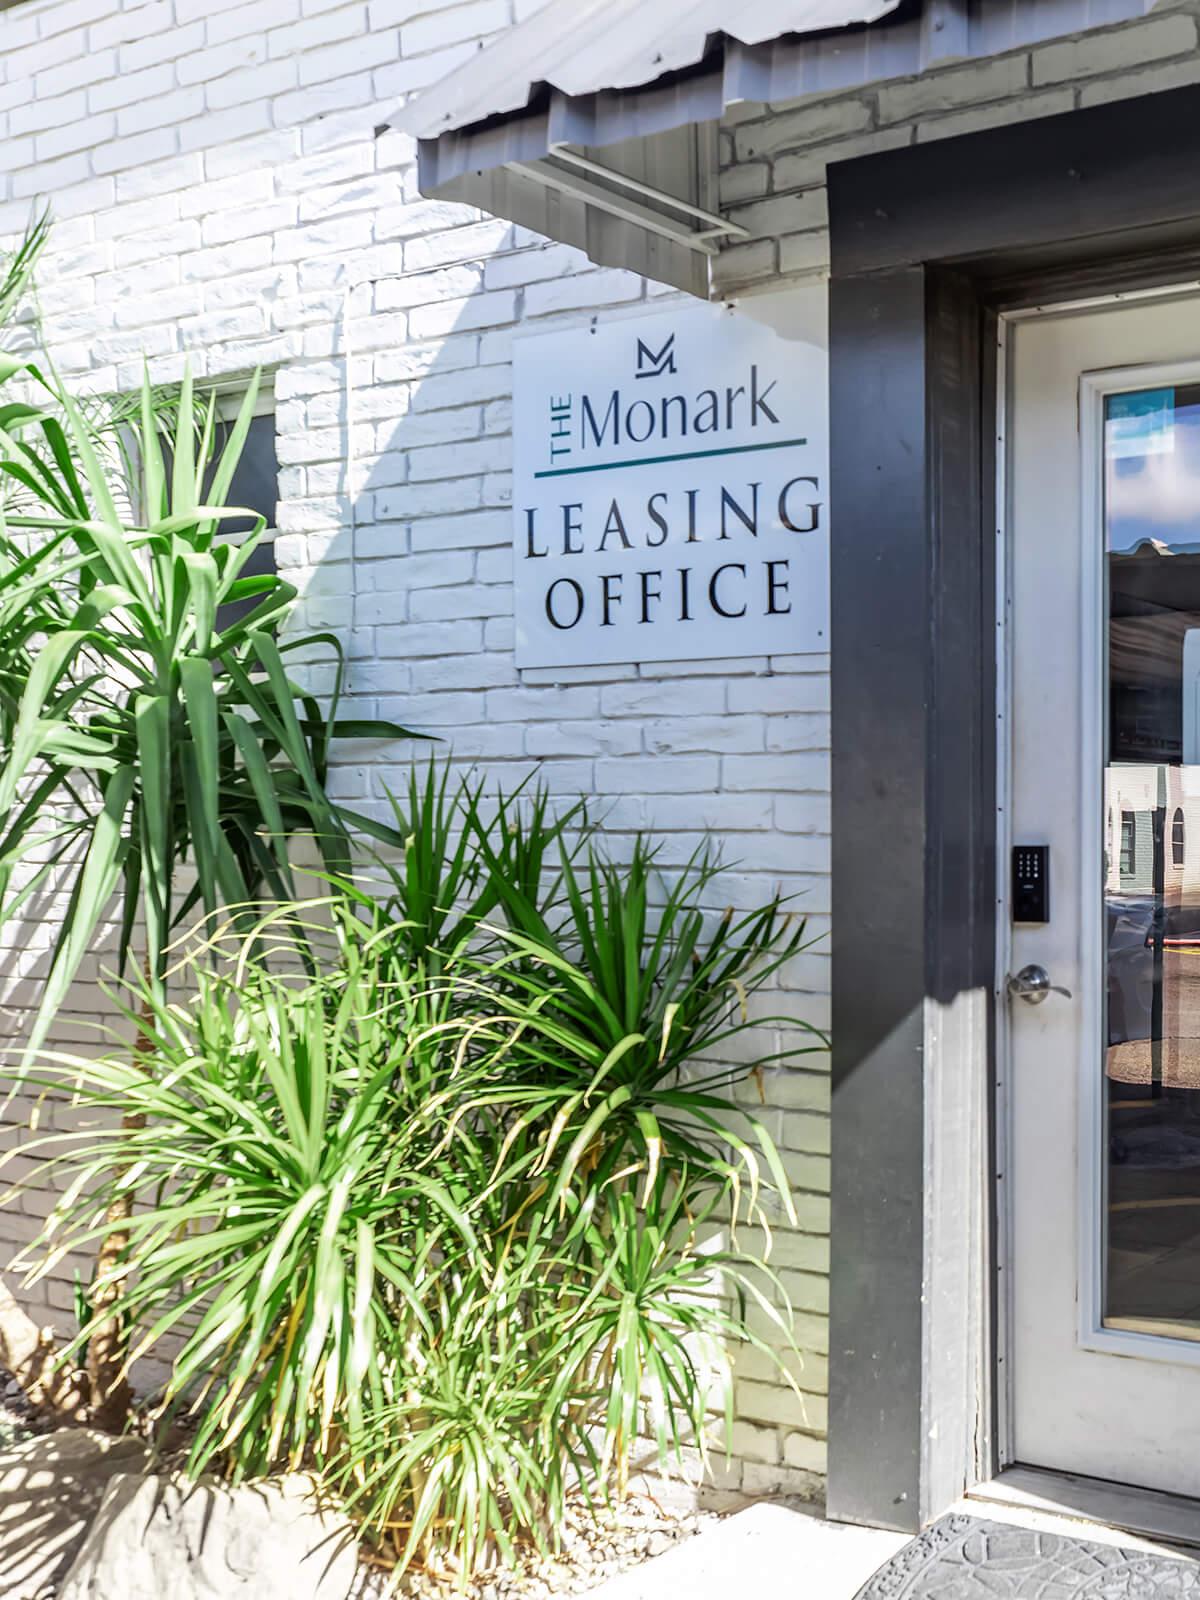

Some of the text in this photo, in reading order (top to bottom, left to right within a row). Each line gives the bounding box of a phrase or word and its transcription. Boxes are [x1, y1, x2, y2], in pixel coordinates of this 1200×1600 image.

[551, 364, 780, 464] THE Monark
[524, 476, 823, 559] LEASING
[545, 559, 792, 630] OFFICE
